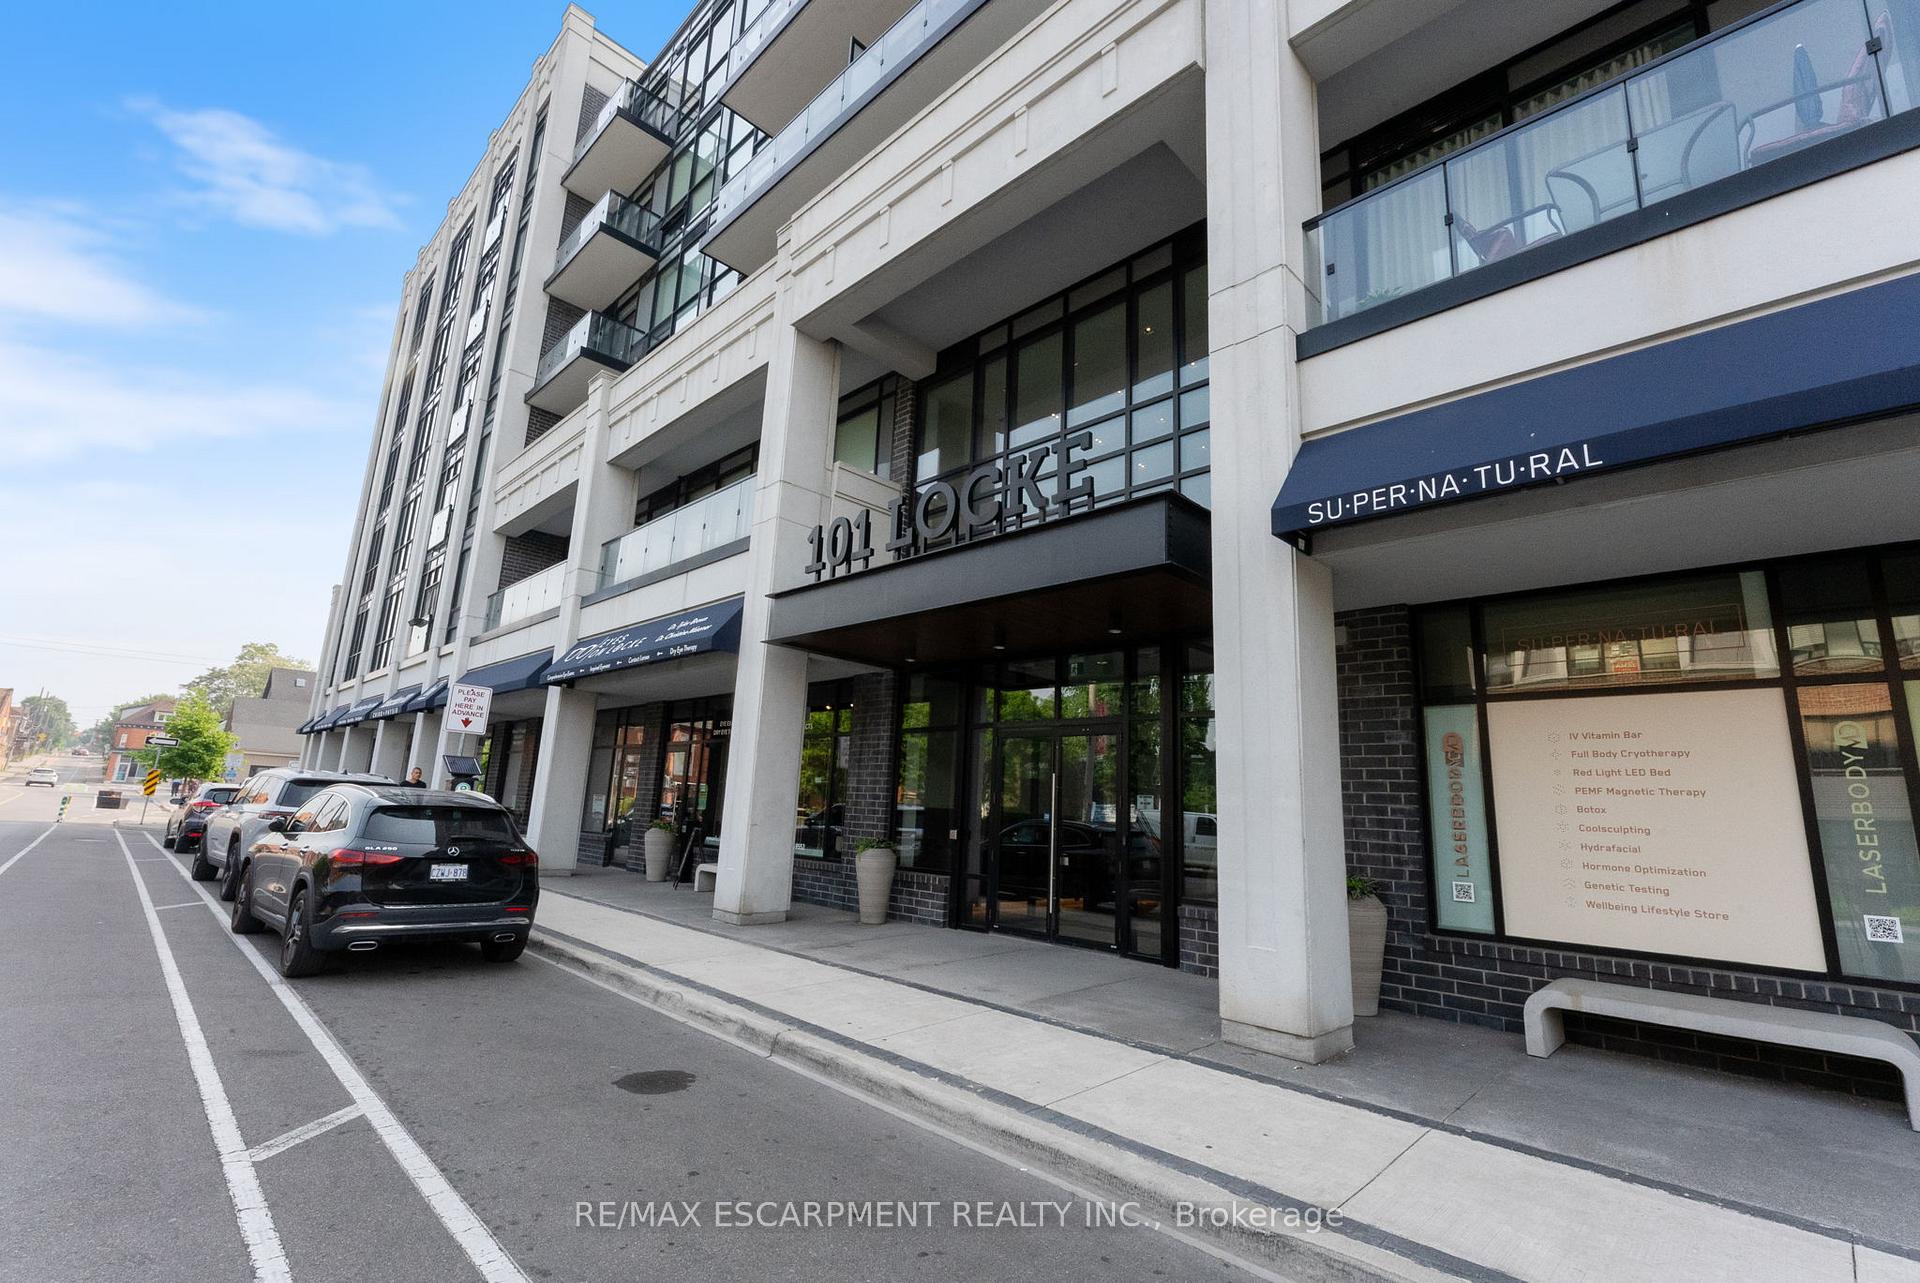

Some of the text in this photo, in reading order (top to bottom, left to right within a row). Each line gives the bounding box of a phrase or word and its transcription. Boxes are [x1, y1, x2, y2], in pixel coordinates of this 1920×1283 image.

[804, 430, 1093, 575] 101 LOCKE
[457, 688, 485, 698] PLEASE
[455, 702, 474, 710] HERE
[451, 709, 485, 719] ADVANCE
[1569, 730, 1643, 741] IV Vitamin Bar
[1571, 749, 1691, 760] Full Body Cryotherapy
[1573, 768, 1671, 778] Red Light LED Bed
[1575, 787, 1706, 798] PEMF Magnetic Therapy
[1576, 805, 1607, 814] Botox
[1578, 824, 1651, 836] Coolsculpting
[1580, 843, 1641, 854] Hydrafacial
[1582, 862, 1707, 877] Hormone Optimization
[1584, 881, 1670, 897] Genetic Testing
[1585, 900, 1729, 921] Wellbeing Lifestyle Store
